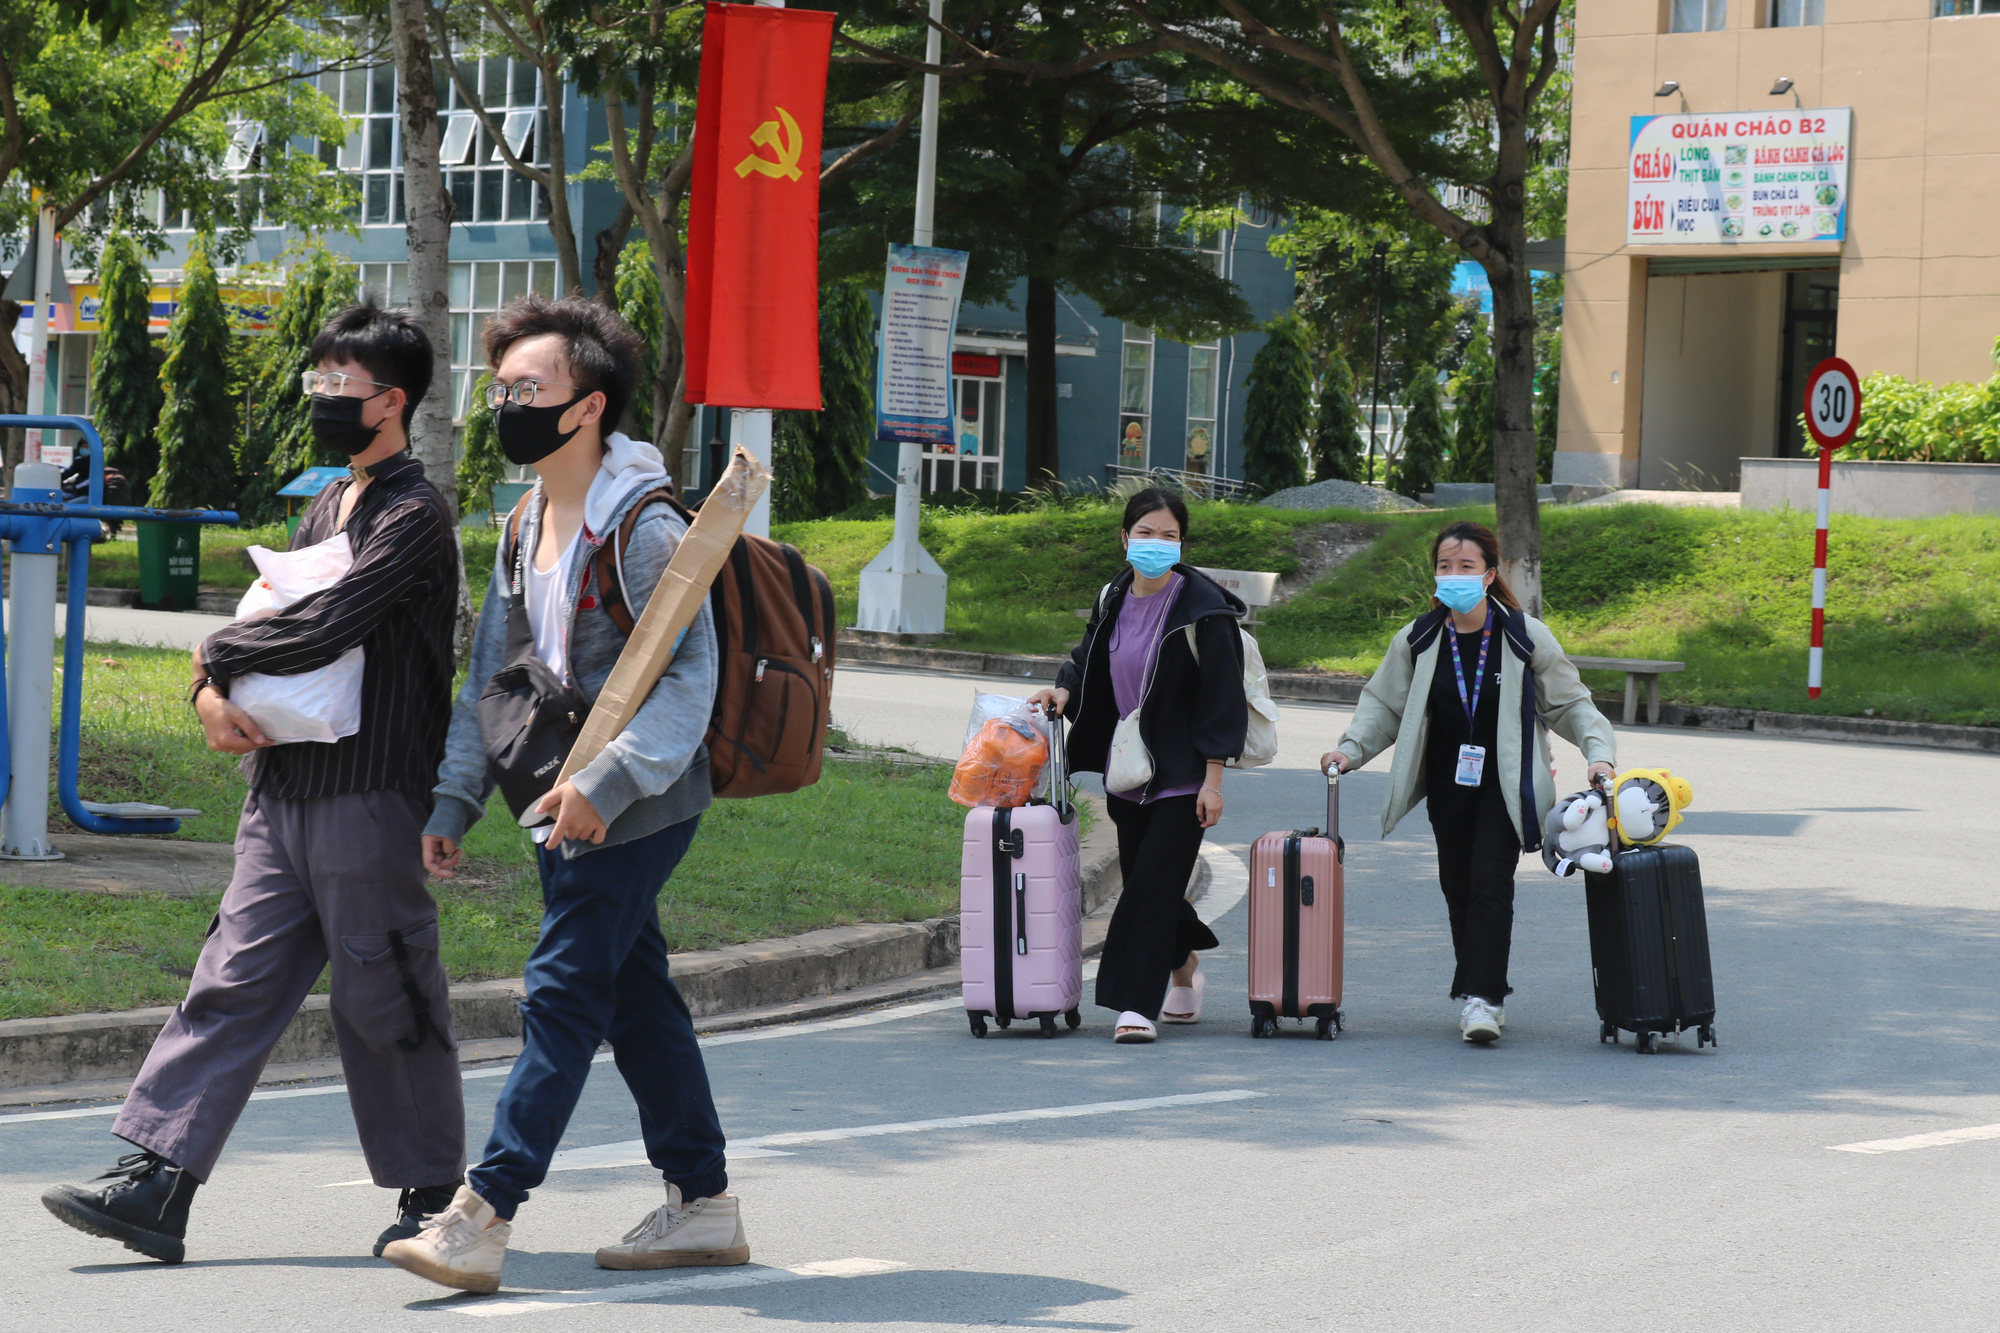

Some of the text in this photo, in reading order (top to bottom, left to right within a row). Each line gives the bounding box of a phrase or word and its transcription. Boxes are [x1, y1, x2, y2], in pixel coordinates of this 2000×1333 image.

[1672, 116, 1826, 139] QUÁN CHÁO B2
[1681, 143, 1710, 161] LÒNG
[1634, 147, 1671, 179] CHÁO
[1679, 168, 1700, 187] THỊT
[1777, 171, 1798, 183] CANH
[1788, 186, 1799, 200] CÁ
[1633, 193, 1665, 230] BÚN
[1677, 196, 1720, 212] RIÊU CUA
[1677, 218, 1695, 236] MỌC
[1819, 383, 1846, 423] 30
